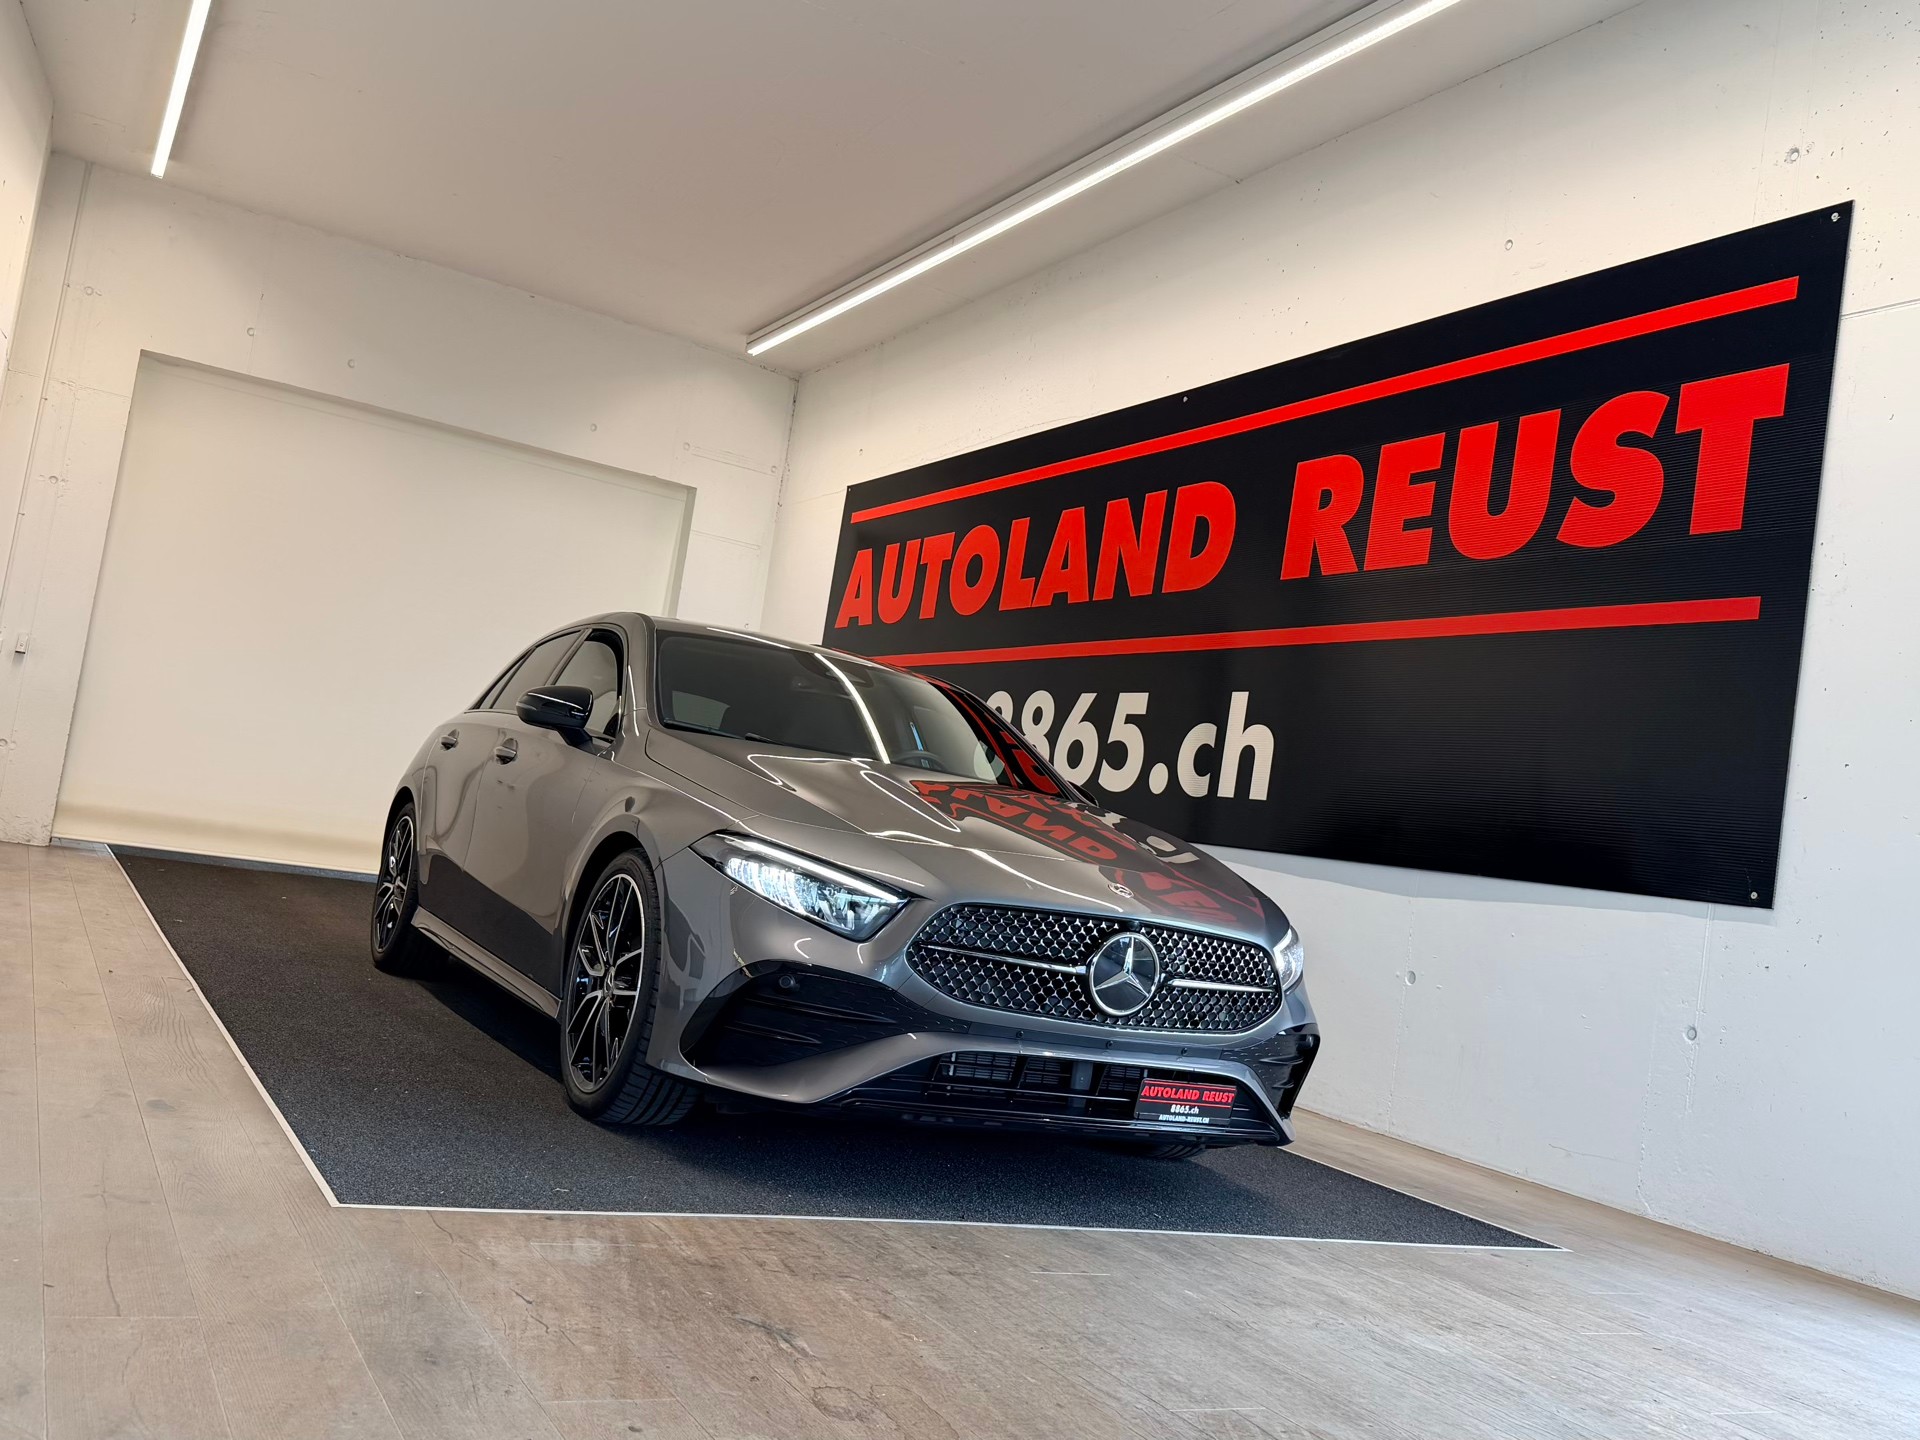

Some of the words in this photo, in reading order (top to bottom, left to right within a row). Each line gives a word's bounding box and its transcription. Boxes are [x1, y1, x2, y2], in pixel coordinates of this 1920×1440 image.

[835, 481, 1237, 629] AUTOLAND
[1281, 363, 1790, 580] REUST
[1141, 1086, 1200, 1100] AUTOLAND
[1203, 1092, 1235, 1103] REUST
[1170, 1104, 1200, 1114] 8865.ch
